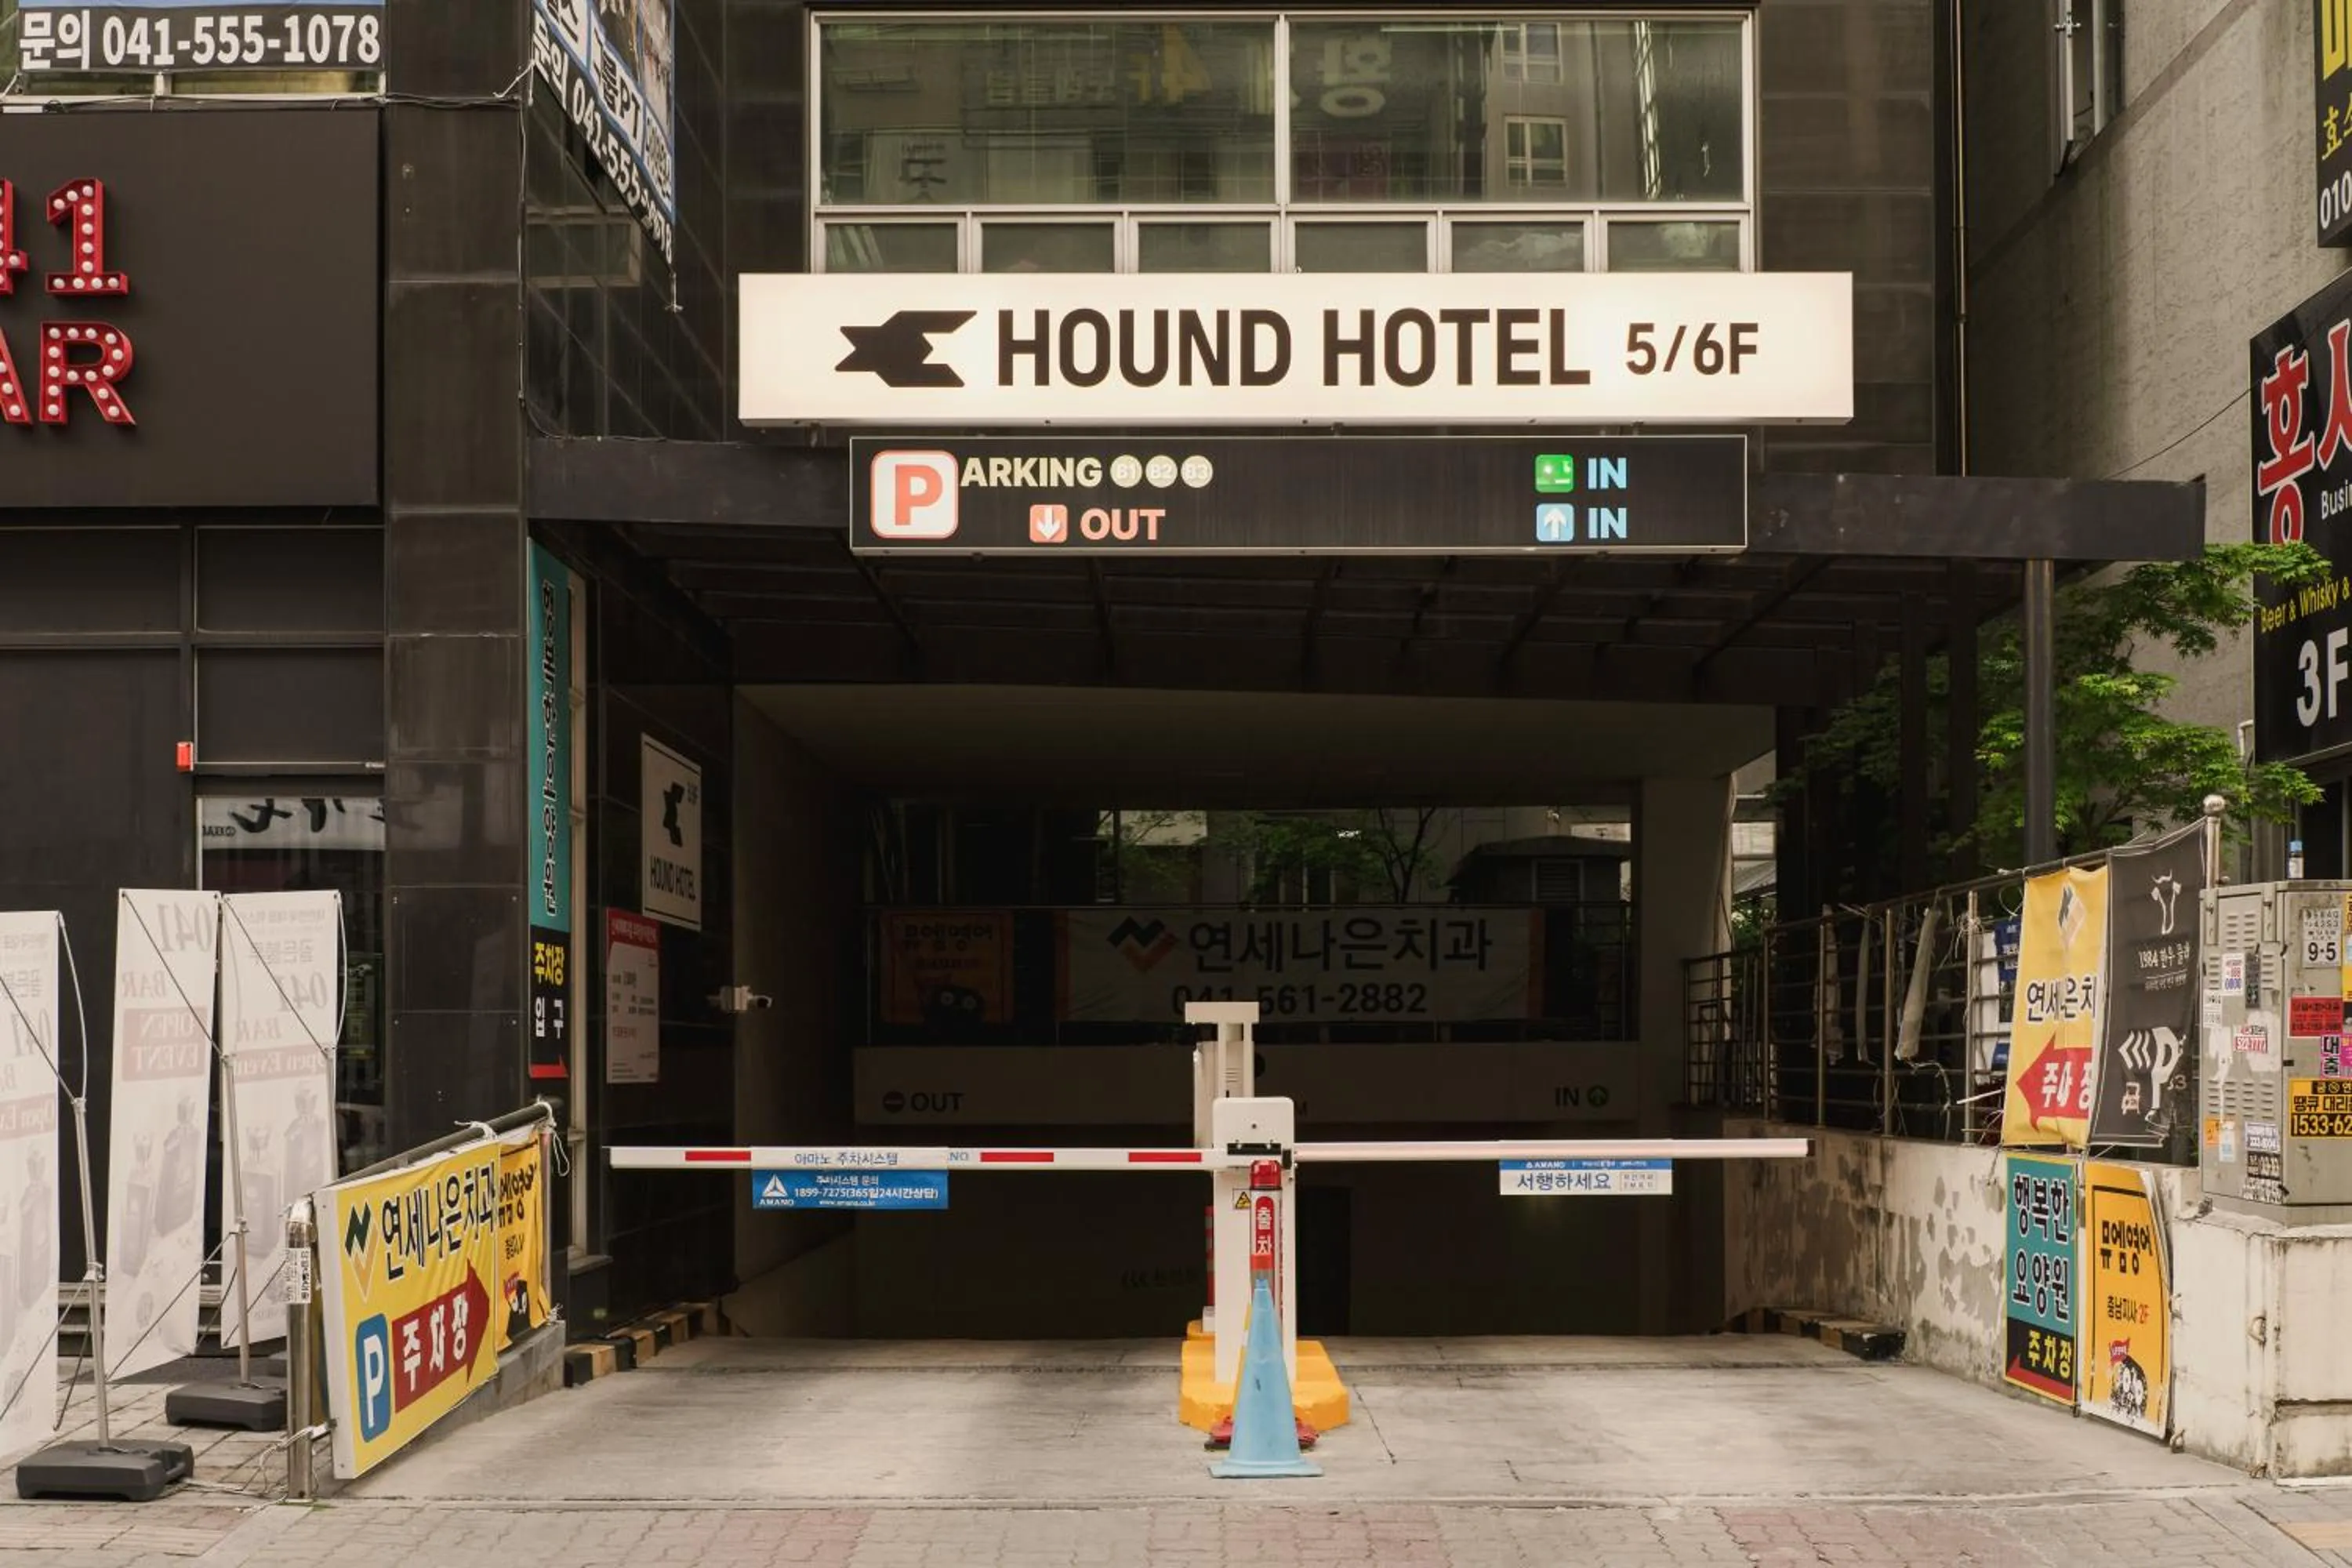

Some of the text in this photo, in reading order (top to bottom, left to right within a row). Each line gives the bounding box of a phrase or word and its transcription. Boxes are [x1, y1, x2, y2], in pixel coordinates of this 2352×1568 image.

[20, 11, 381, 70] 문의 041-555-1078
[533, 10, 568, 111] 문의
[998, 307, 1759, 388] HOUND HOTEL 5/6F
[1588, 457, 1628, 489] IN
[1079, 507, 1628, 541] OUT IN
[2260, 603, 2287, 633] Beer
[2299, 581, 2339, 618] Whisky
[2296, 626, 2349, 728] 3F
[1189, 916, 1493, 973] 연세나은치과
[534, 996, 564, 1040] 입구
[1172, 983, 1427, 1016] 041561-2882
[910, 1092, 964, 1112] OUT
[1555, 1087, 1580, 1108] IN
[2323, 1095, 2352, 1112] 대리
[2293, 1114, 2352, 1135] 1533-62
[794, 1151, 899, 1165] 아마노 주차시스템
[1518, 1172, 1611, 1191] 서행하세요
[382, 1160, 496, 1281] 연세나은치과
[2013, 1173, 2069, 1243] 행복한
[2100, 1220, 2153, 1275] 뮤엠영어
[2012, 1250, 2069, 1324] 요양원
[363, 1292, 470, 1429] P 주차장
[2028, 1330, 2072, 1377] 주차장
